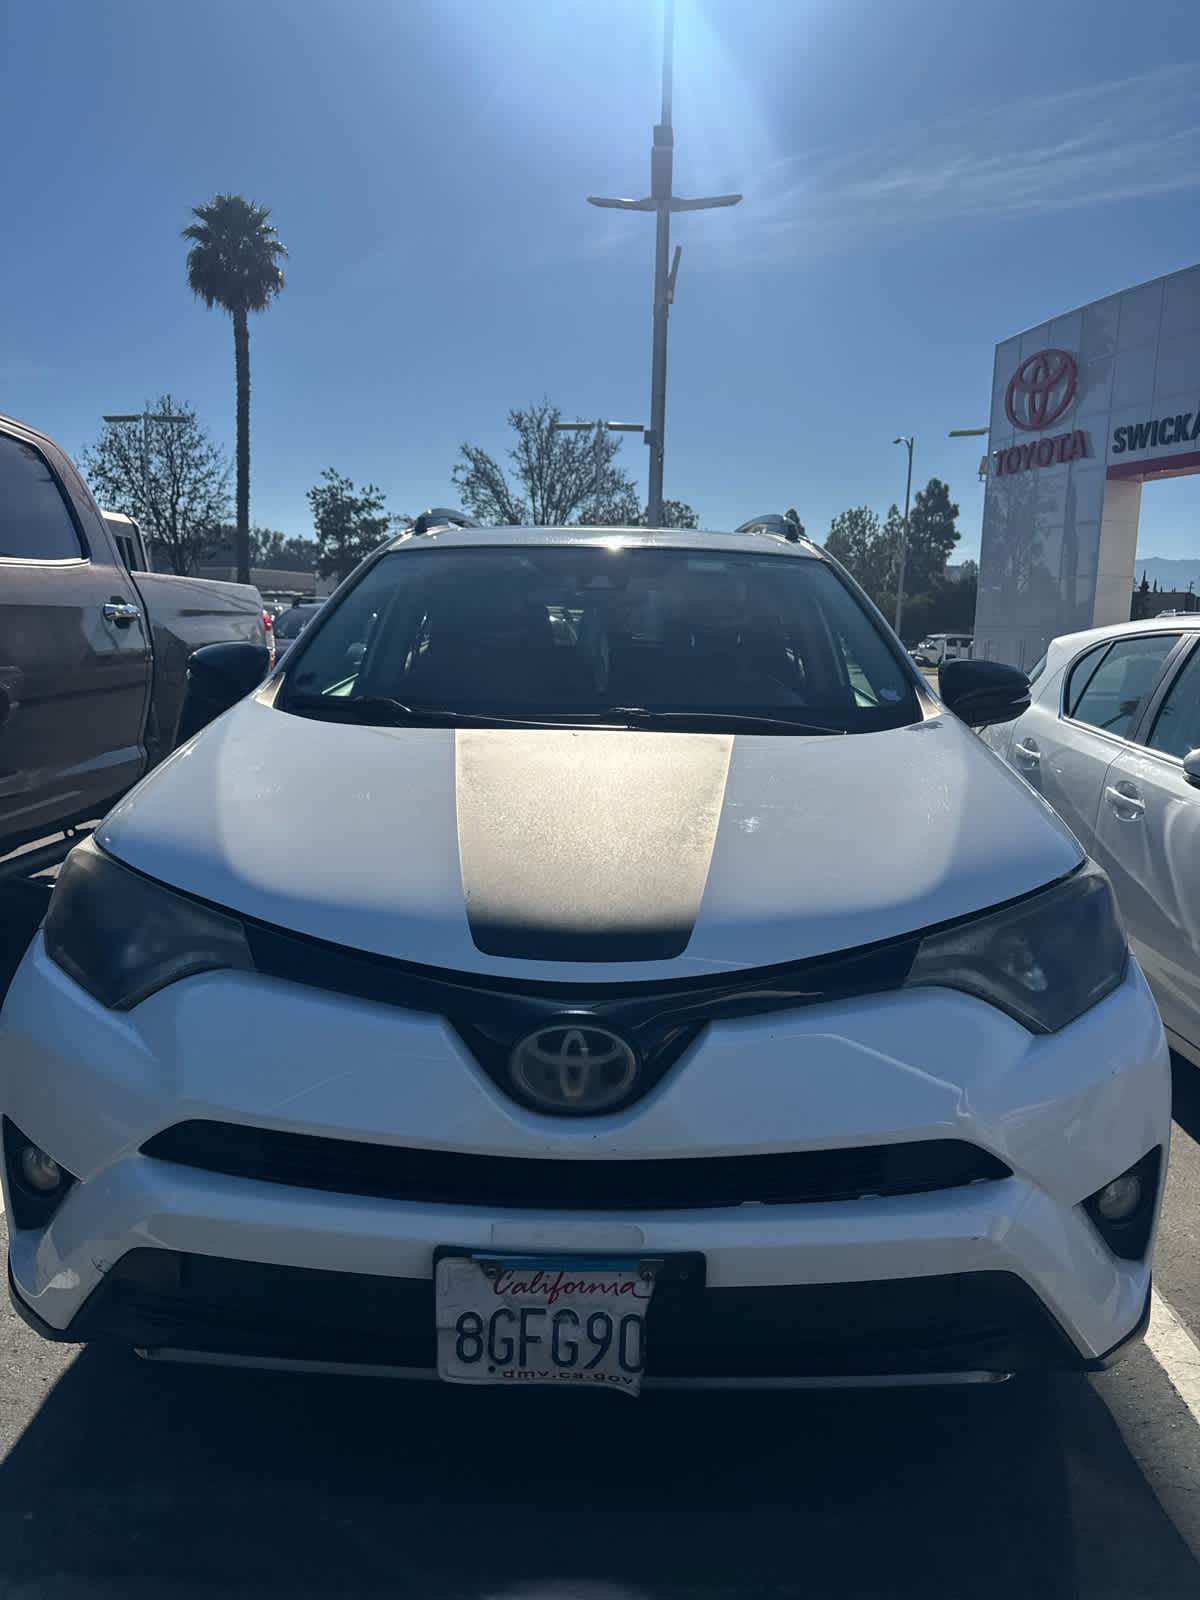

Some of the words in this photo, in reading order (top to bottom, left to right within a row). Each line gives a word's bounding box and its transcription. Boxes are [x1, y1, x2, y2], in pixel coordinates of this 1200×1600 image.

[994, 430, 1088, 476] TOYOTA
[492, 1269, 651, 1304] California
[502, 1368, 633, 1385] dmv.ca.gov
